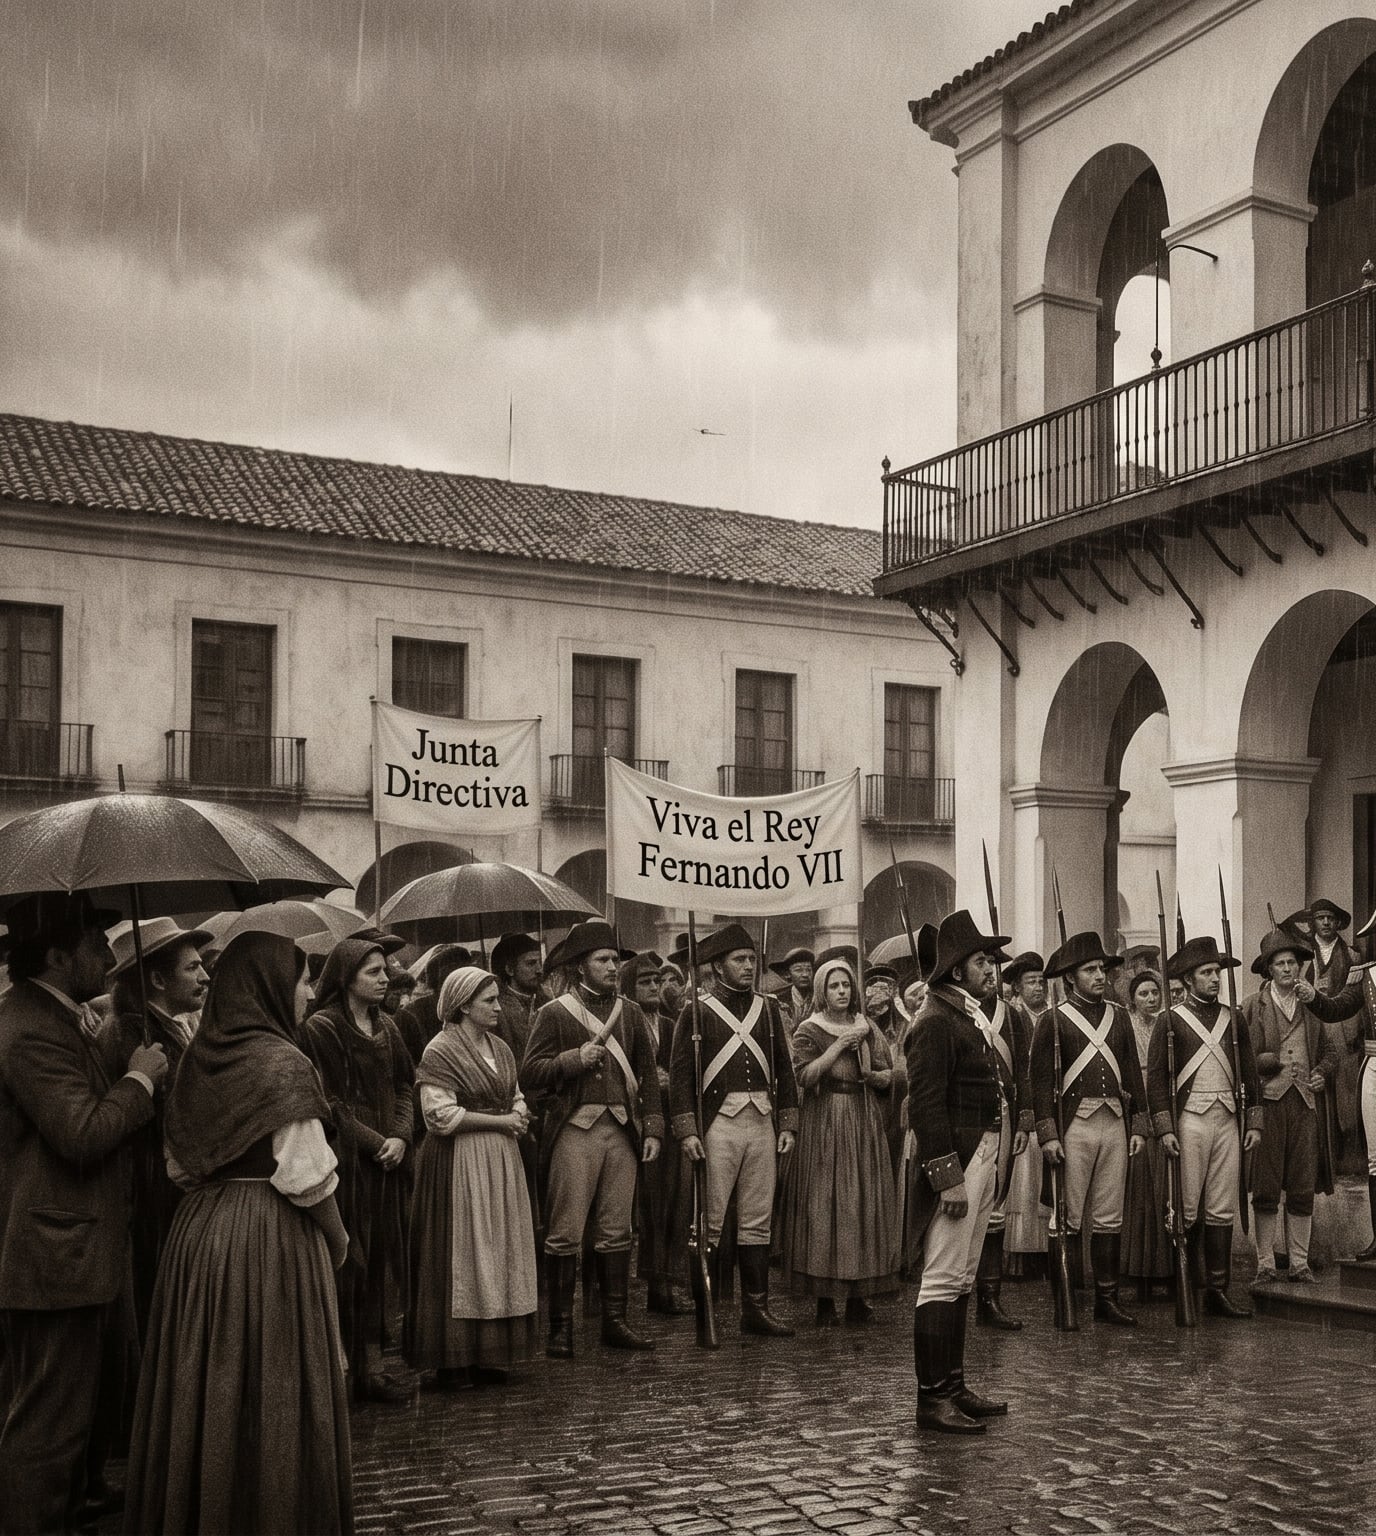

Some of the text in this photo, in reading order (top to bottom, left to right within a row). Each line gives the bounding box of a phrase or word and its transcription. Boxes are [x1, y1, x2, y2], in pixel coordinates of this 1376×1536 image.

[411, 728, 499, 768] Junta
[384, 763, 529, 809] Directiva
[645, 796, 821, 850] Viva el Rey
[638, 842, 844, 889] Fernando VII
